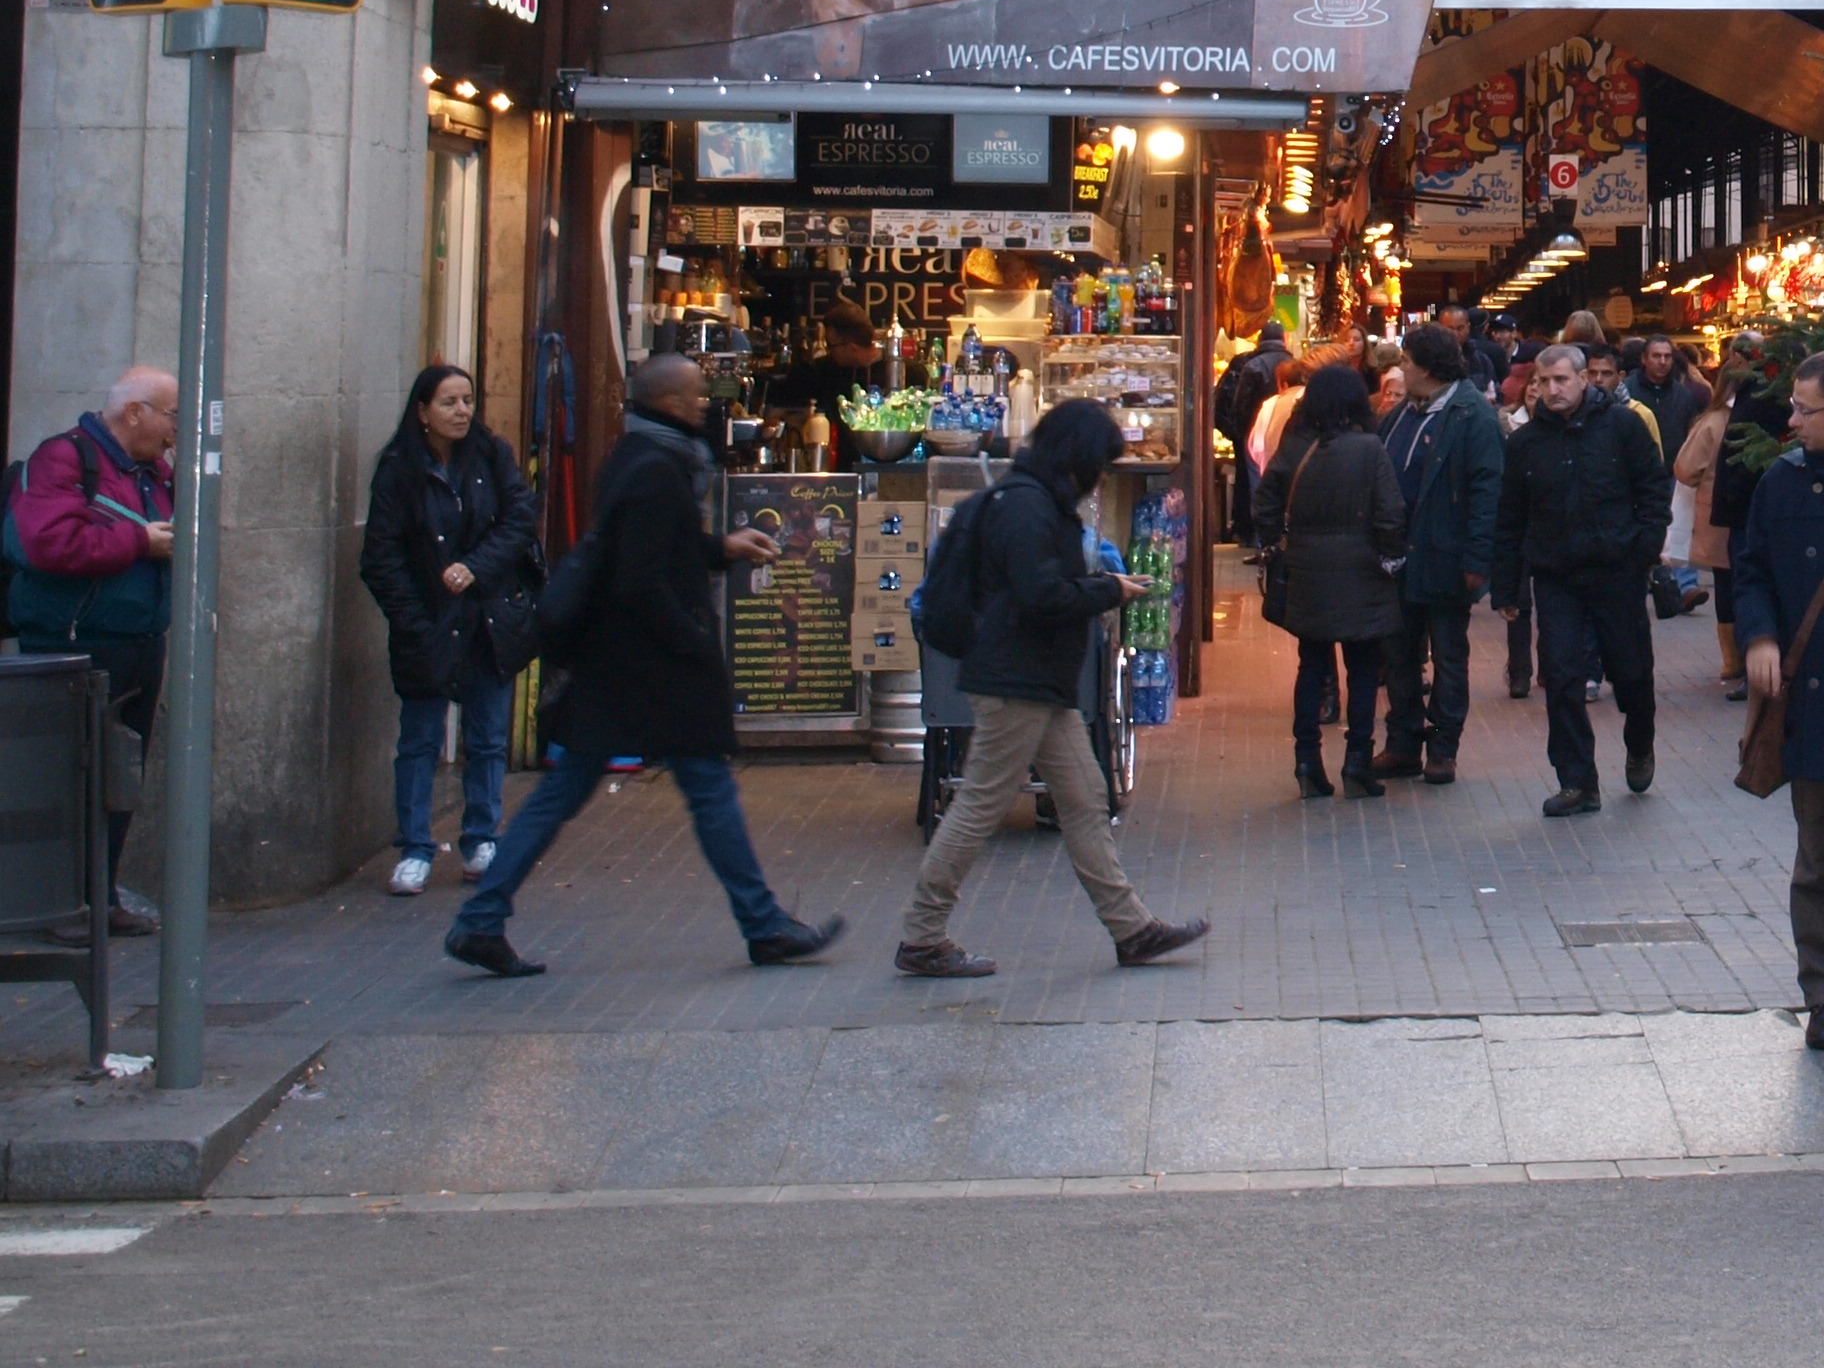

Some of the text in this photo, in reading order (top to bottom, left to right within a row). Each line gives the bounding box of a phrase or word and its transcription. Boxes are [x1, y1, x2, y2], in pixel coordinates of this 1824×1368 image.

[818, 142, 931, 163] ESPRESSO
[966, 152, 1040, 165] ESPRESSO
[1074, 166, 1109, 182] BREAKFAST
[1557, 166, 1570, 184] 6
[812, 185, 934, 197] www.cafesvitoria.com
[790, 485, 820, 500] Coffee
